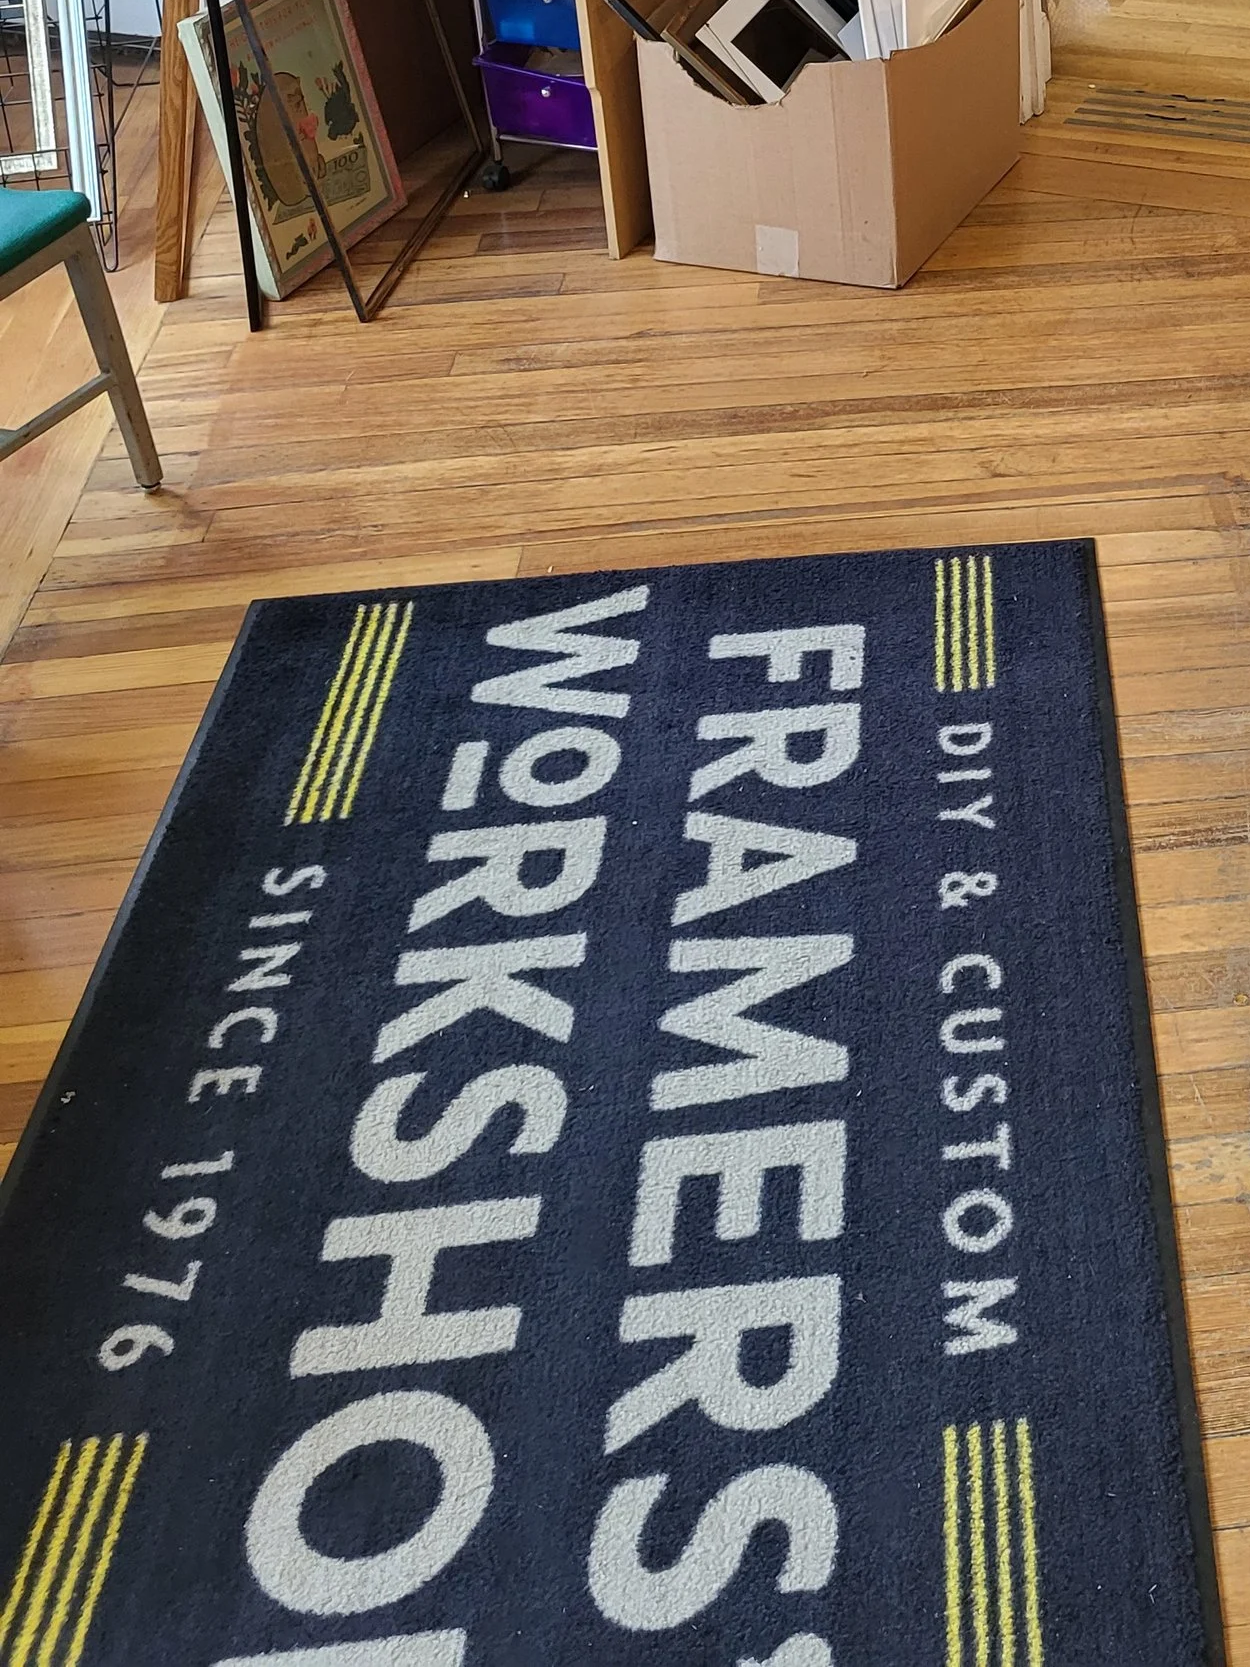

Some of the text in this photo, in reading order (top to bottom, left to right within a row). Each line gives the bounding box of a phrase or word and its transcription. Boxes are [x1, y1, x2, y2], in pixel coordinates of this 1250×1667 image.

[97, 863, 327, 1372] SINCE 1976
[934, 720, 1019, 1357] DIY & CUSTOM
